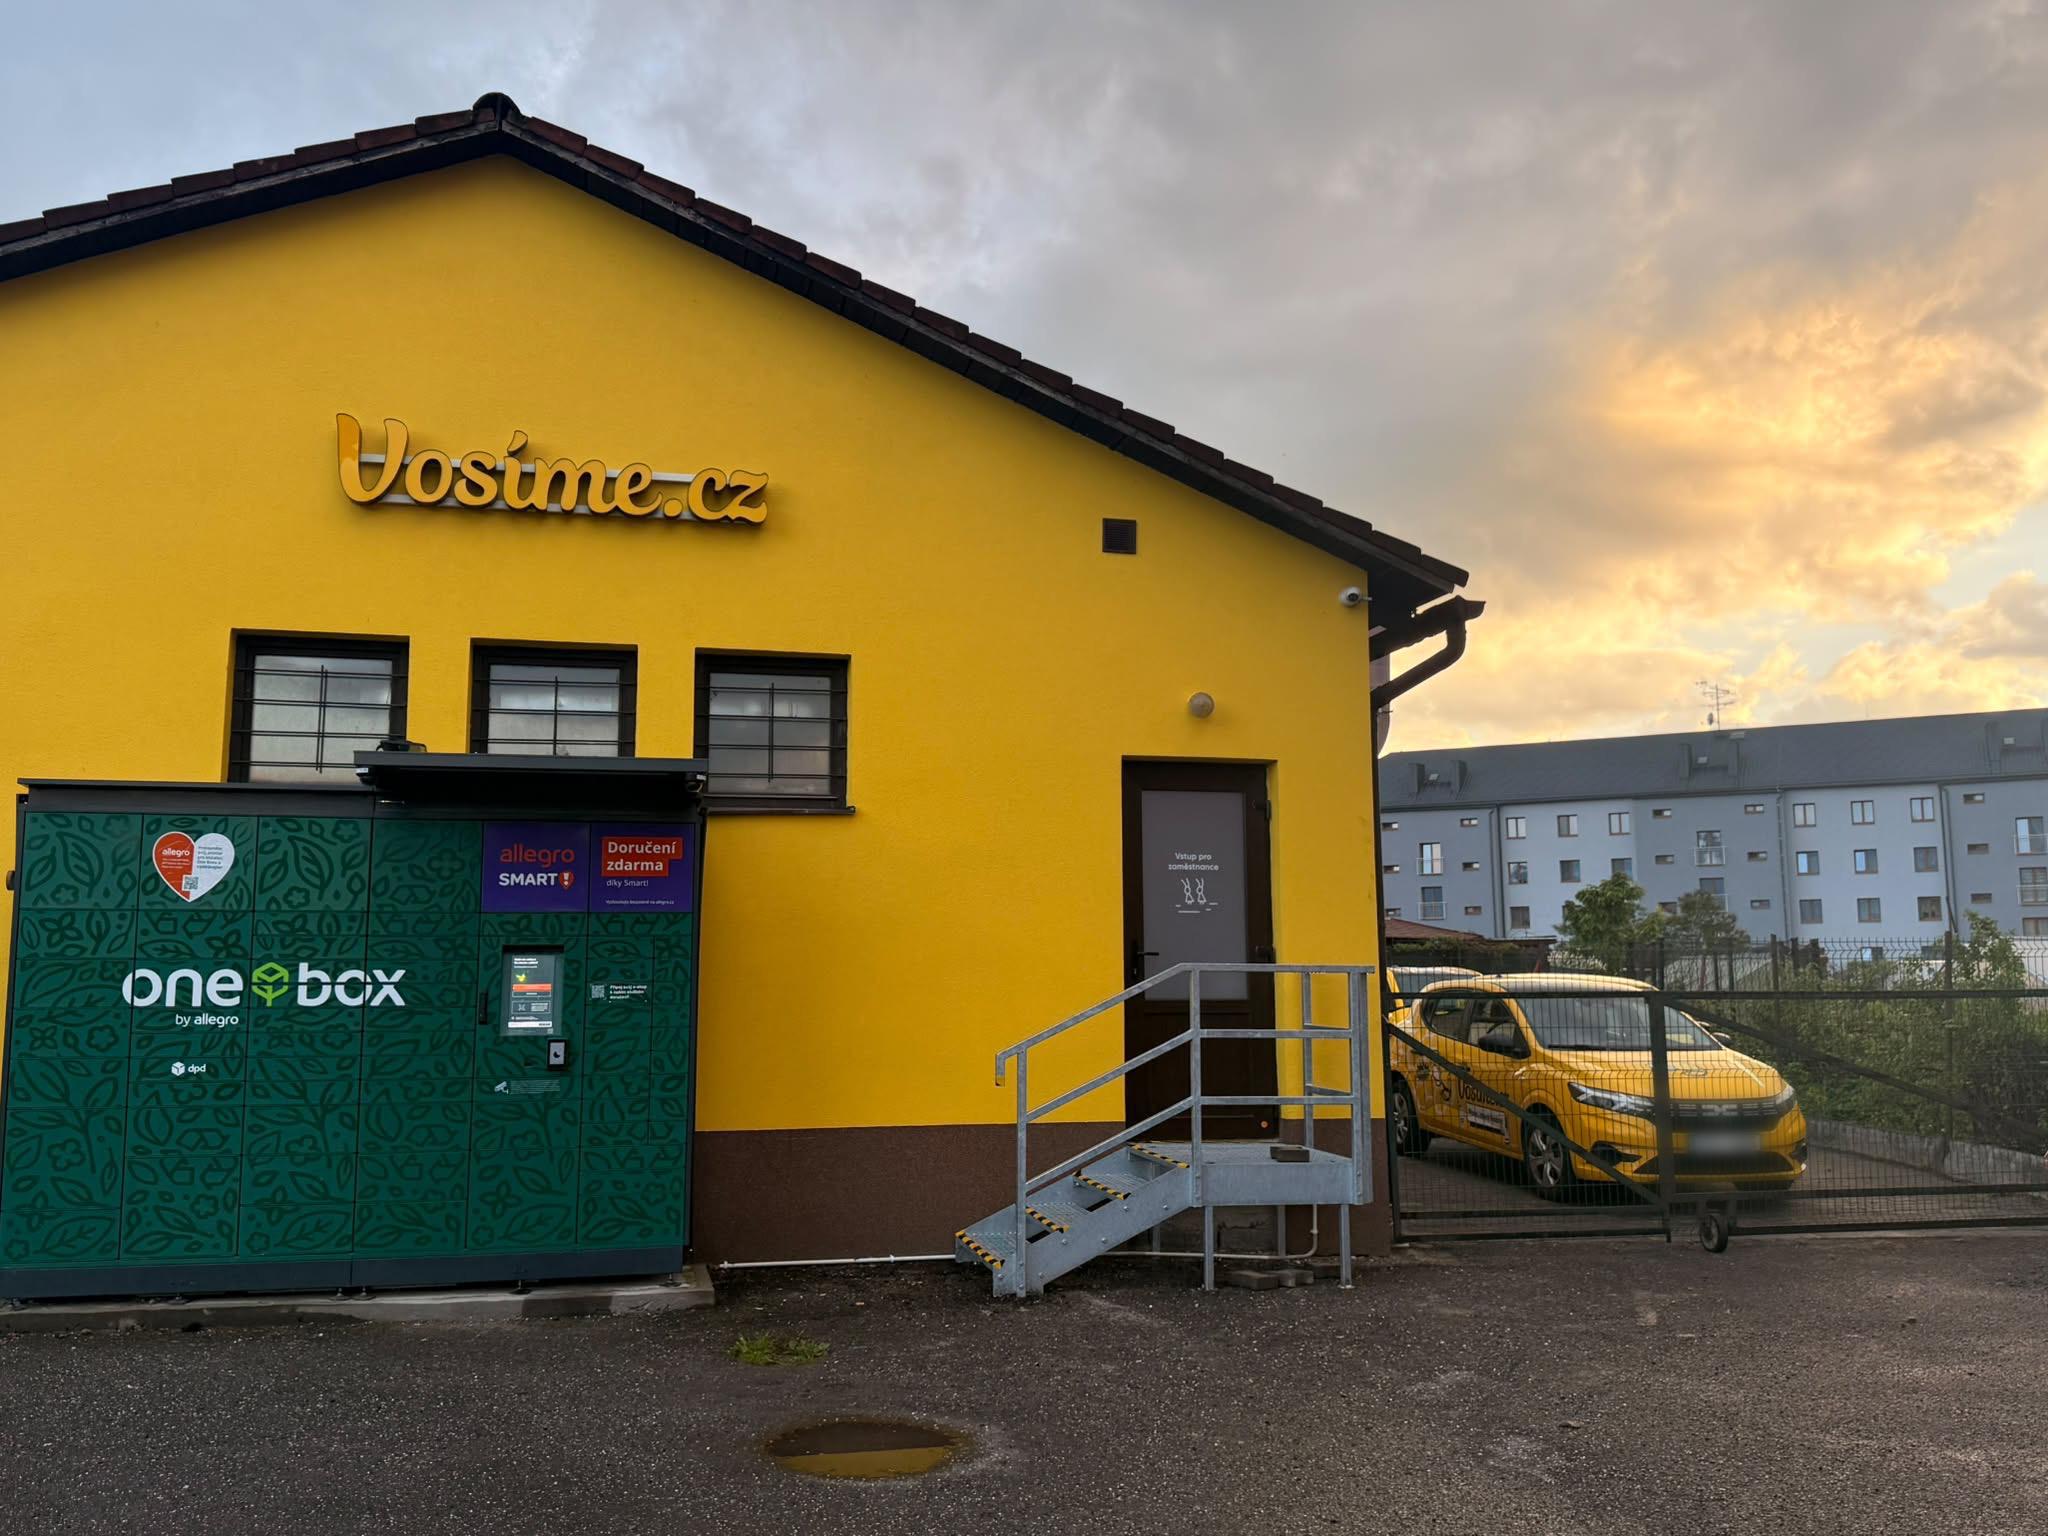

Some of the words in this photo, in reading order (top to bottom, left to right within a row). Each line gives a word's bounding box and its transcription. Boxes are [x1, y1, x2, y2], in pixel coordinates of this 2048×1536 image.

[336, 413, 769, 525] Vosíme.cz
[161, 847, 191, 858] allegro
[607, 840, 677, 855] Doručení
[500, 844, 575, 867] allegro
[1175, 852, 1197, 861] Vstup
[606, 859, 664, 872] zdarma
[606, 878, 623, 889] díky
[122, 968, 243, 1007] one
[297, 962, 406, 1007] box
[175, 1012, 191, 1026] by
[193, 1012, 239, 1028] allegro
[187, 1062, 207, 1075] dpd
